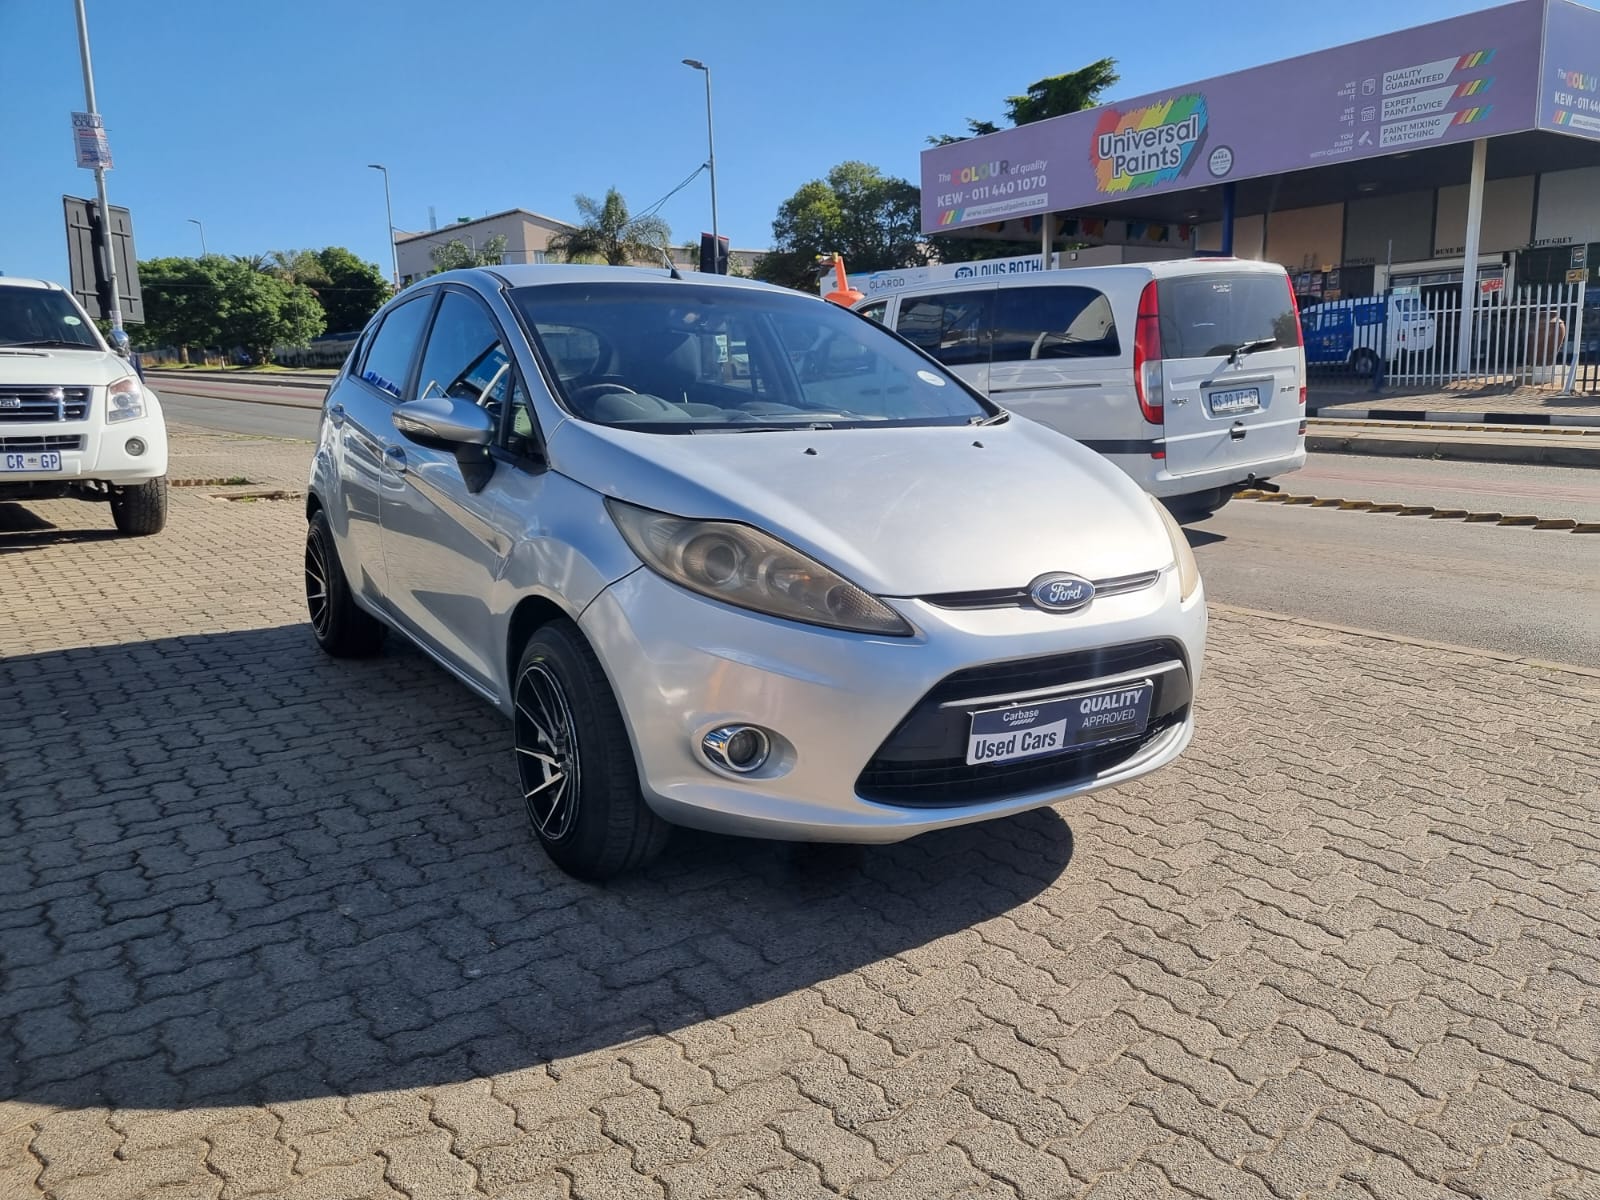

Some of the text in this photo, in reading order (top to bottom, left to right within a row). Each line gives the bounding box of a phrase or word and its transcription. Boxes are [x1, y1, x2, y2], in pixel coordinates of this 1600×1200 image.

[1386, 69, 1422, 83] QUALITY
[1386, 73, 1444, 90] GUARANTEED
[1566, 71, 1600, 92] COLOU
[1384, 97, 1416, 109] EXPERT
[1384, 100, 1443, 118] PAINT ADVICE
[1554, 91, 1573, 107] KEW
[1577, 97, 1589, 110] 011
[1099, 115, 1198, 158] Universal
[1383, 119, 1441, 136] PAINT MIXING
[1389, 129, 1434, 141] MATCHING
[1114, 146, 1180, 178] Paints
[938, 159, 1048, 187] The COLOUR of quality
[937, 192, 963, 208] KEW
[972, 187, 989, 200] 011
[992, 182, 1014, 197] 440
[1017, 175, 1047, 191] 1070
[1009, 259, 1043, 273] BOTH
[6, 454, 58, 469] CR GP
[1050, 581, 1083, 602] Ford
[1079, 689, 1143, 714] QUALITY
[1003, 708, 1039, 722] Carbase
[1081, 708, 1136, 728] APPROVED
[974, 730, 1057, 760] Used Cars
